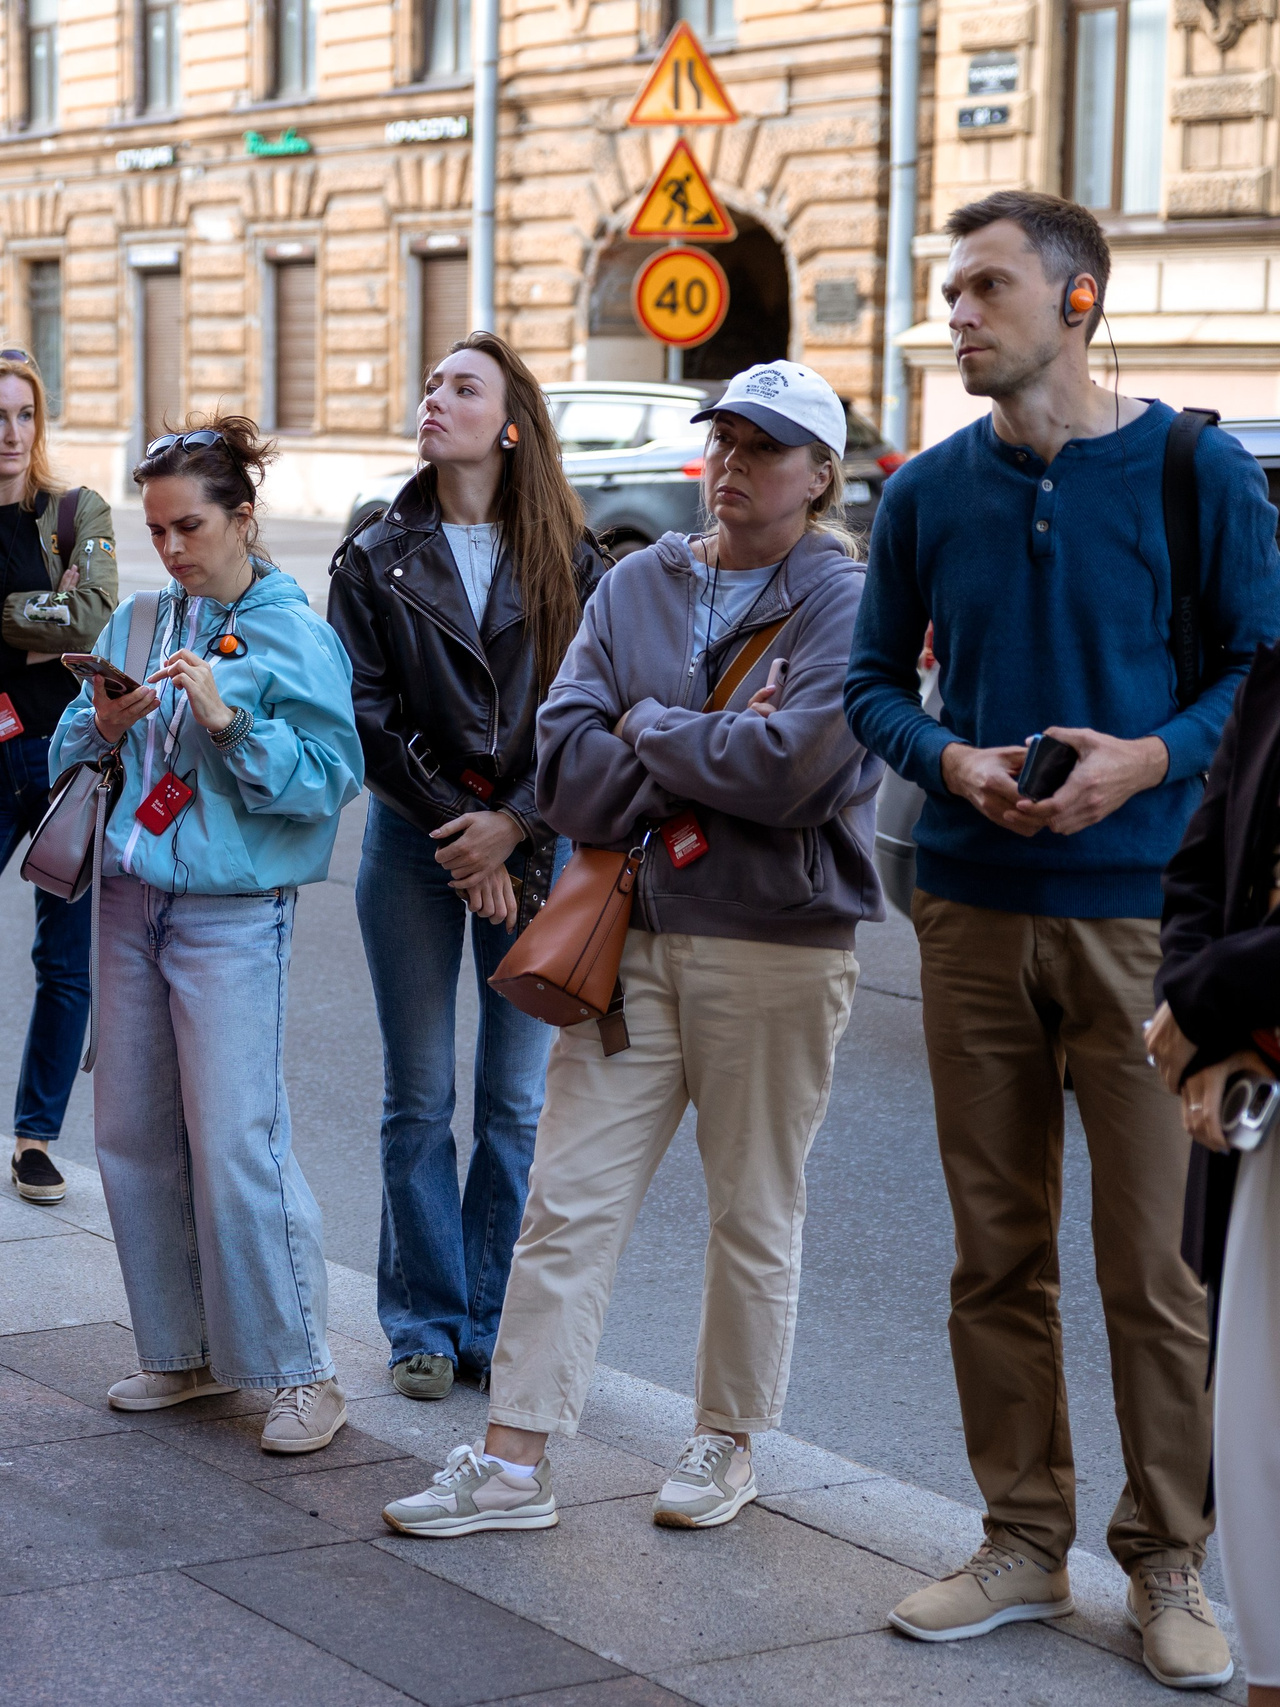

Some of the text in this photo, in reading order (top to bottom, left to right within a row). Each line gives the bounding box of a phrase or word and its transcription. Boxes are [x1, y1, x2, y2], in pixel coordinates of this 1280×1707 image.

[655, 278, 708, 316] 40
[1181, 595, 1195, 694] ENDERSON
[154, 799, 164, 808] Red
